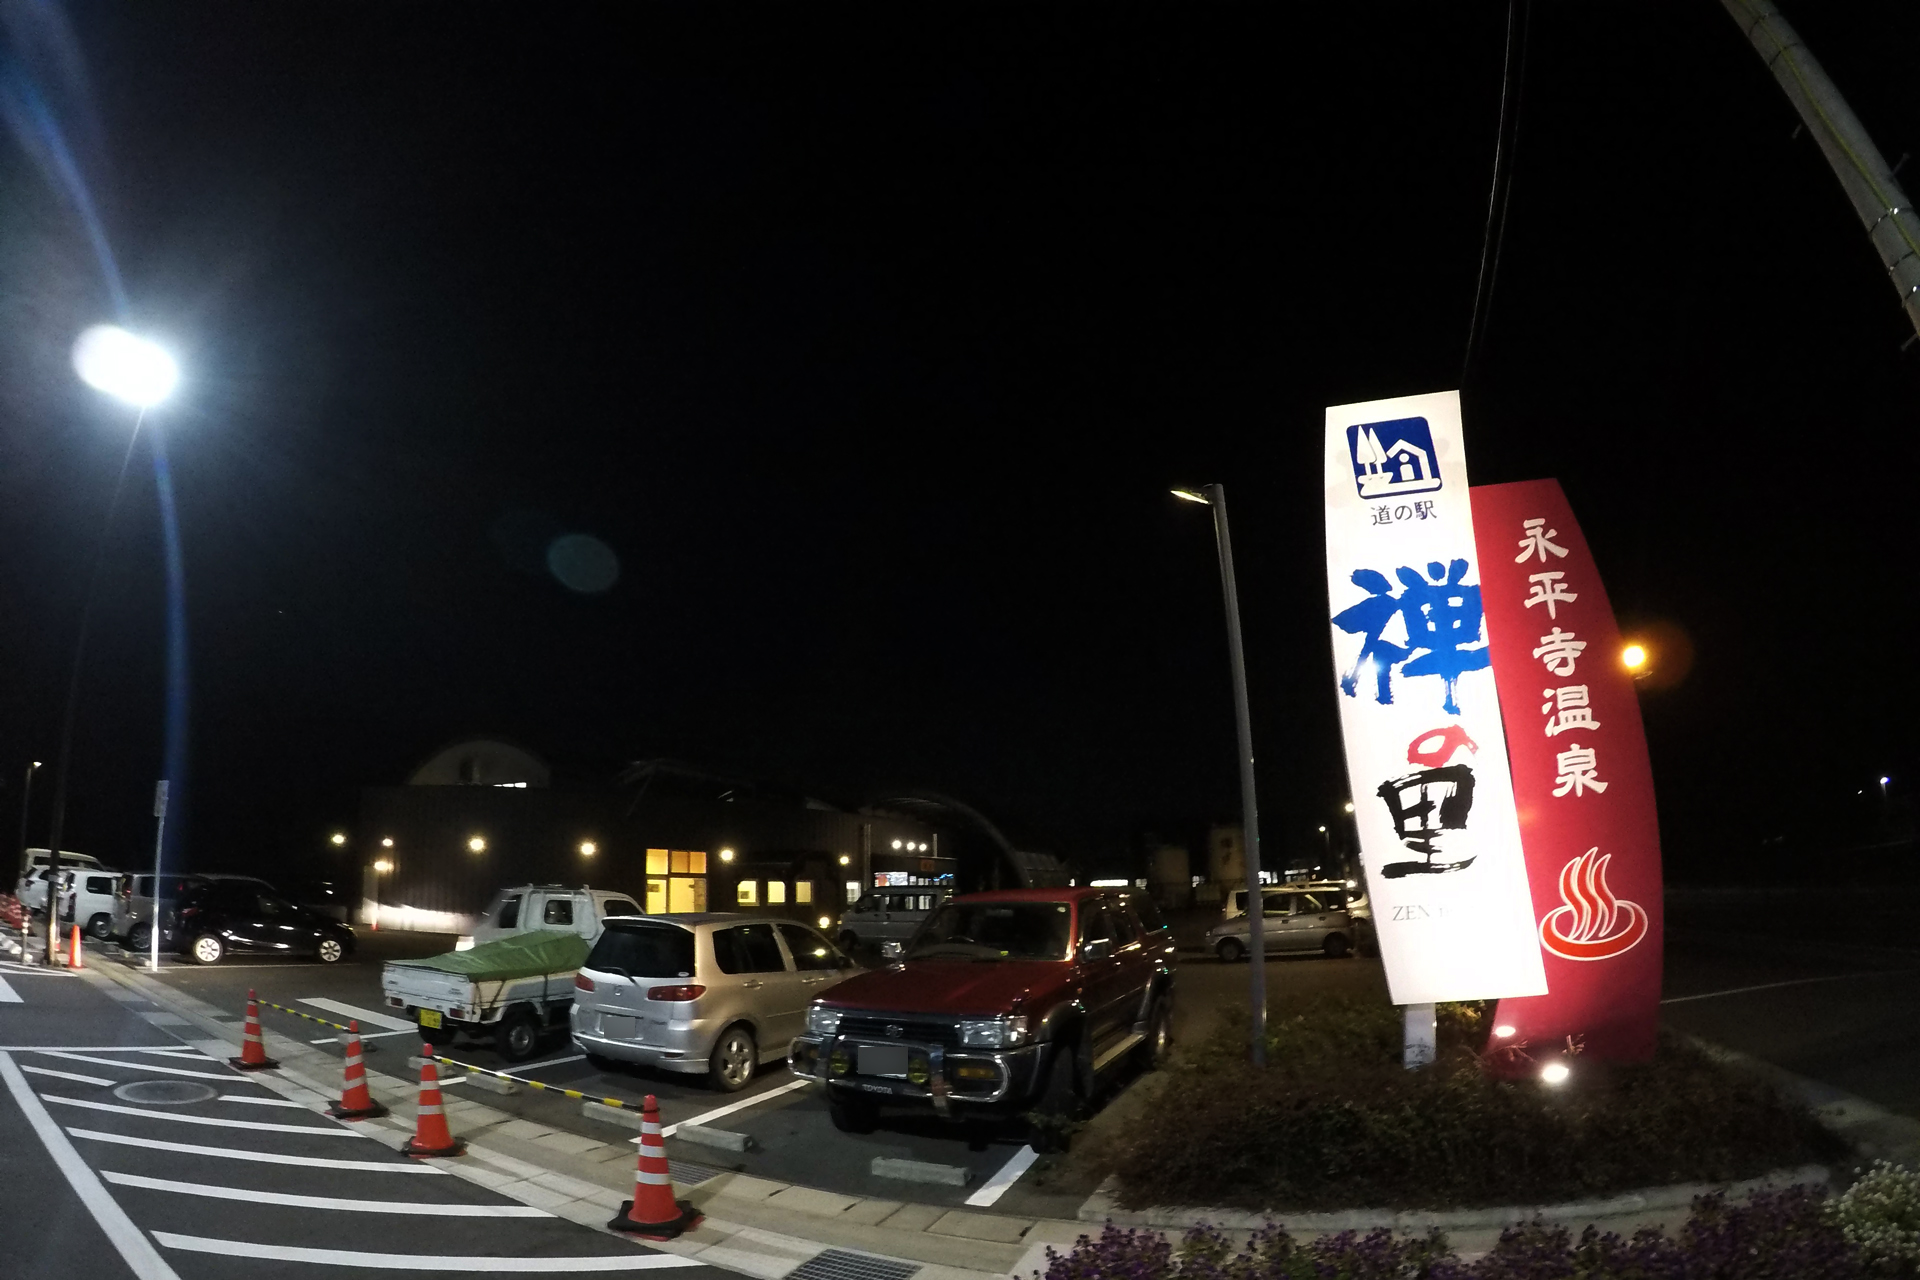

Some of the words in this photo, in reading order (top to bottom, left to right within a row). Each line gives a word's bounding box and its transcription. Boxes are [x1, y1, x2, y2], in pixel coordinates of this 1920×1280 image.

[1371, 500, 1438, 526] 道の駅
[1331, 557, 1491, 880] 禅の里
[1514, 517, 1608, 798] 永平寺温泉
[861, 1083, 894, 1095] TOYOTA
